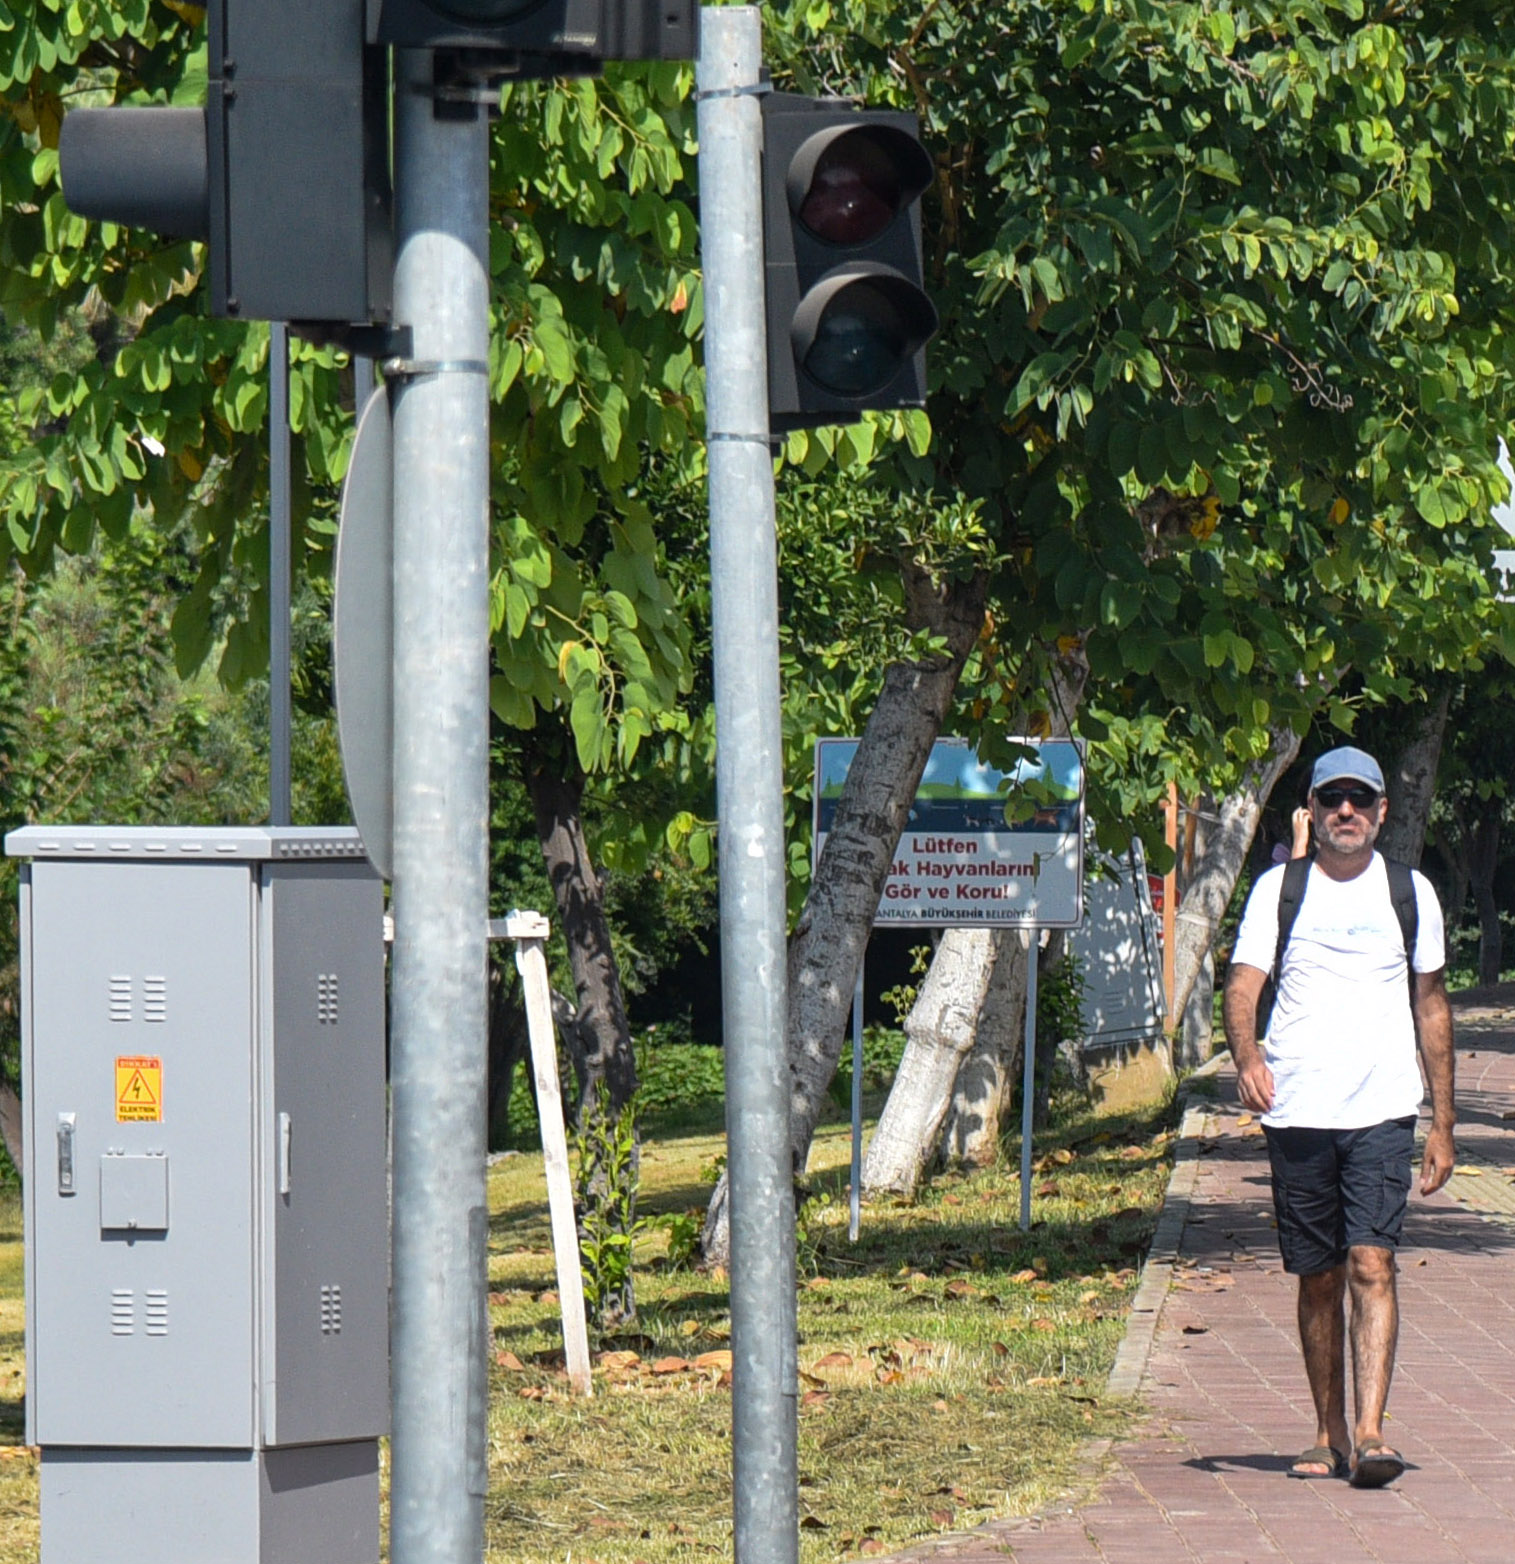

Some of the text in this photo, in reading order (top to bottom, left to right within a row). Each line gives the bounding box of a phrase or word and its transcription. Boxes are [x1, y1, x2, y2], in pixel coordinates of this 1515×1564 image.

[912, 837, 978, 854] Lütfen
[917, 860, 1035, 881] Hayvanların
[885, 882, 1009, 900] Gör ve Koru!
[876, 908, 920, 920] ANTALYA
